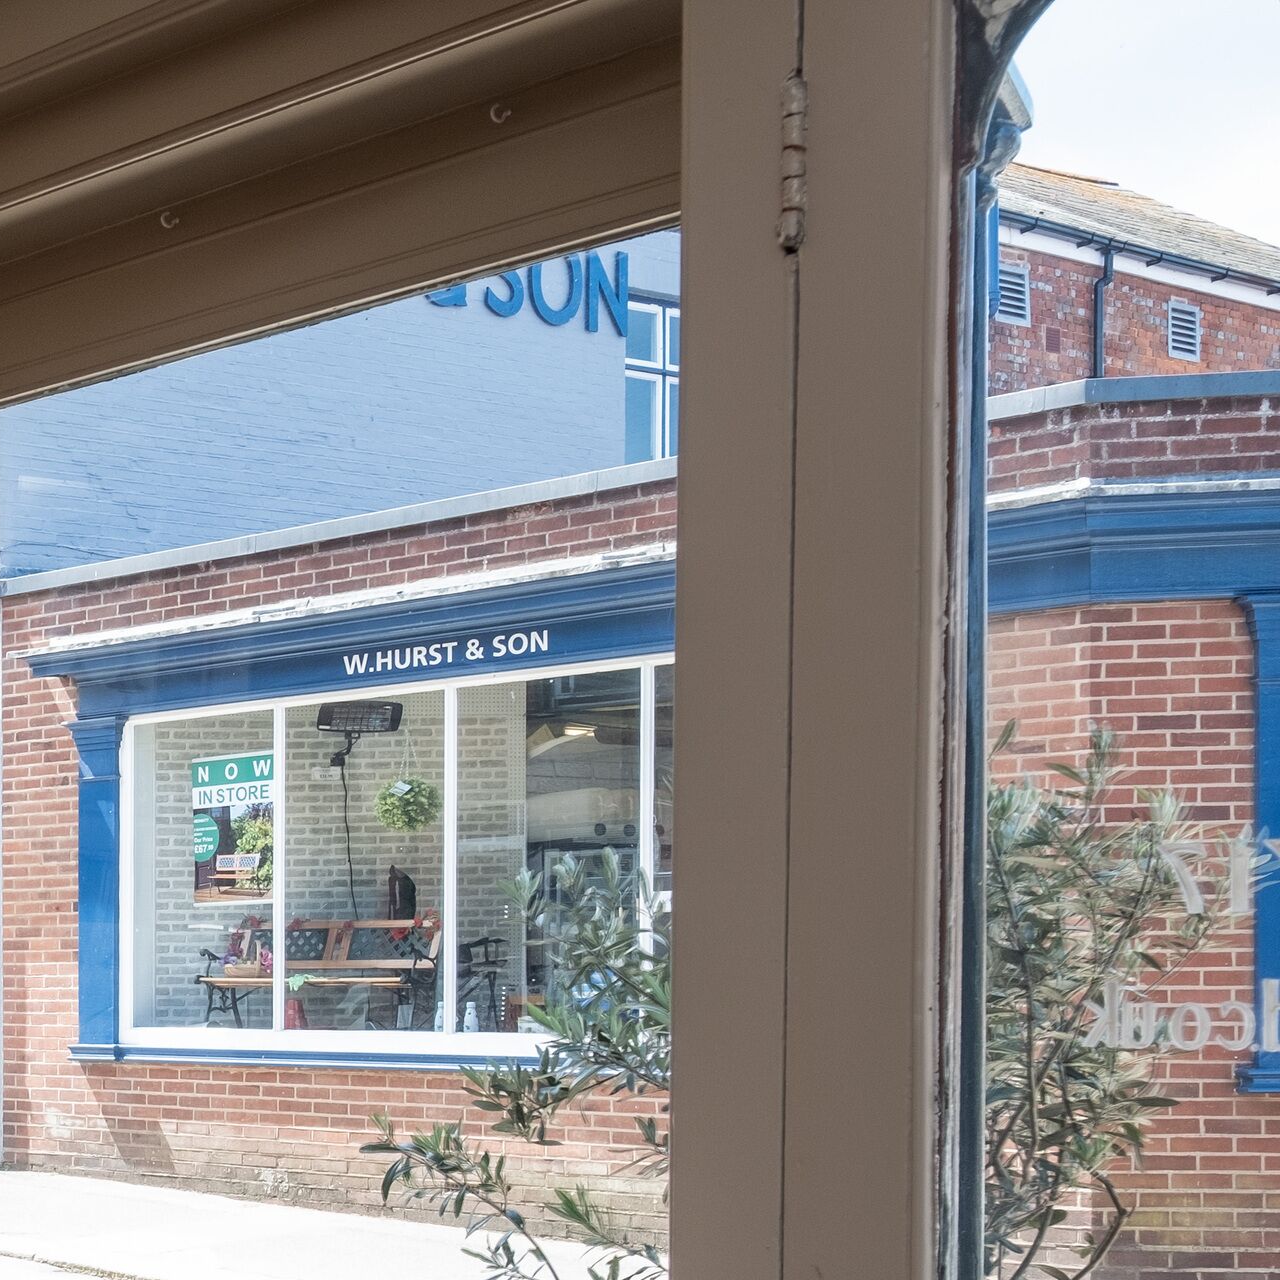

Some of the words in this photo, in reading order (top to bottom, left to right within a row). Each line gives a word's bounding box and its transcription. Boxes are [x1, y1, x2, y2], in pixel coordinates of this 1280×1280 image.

[484, 251, 628, 337] SON
[343, 641, 458, 676] W.HURST
[465, 639, 484, 661] &
[492, 630, 549, 657] SON
[198, 759, 271, 783] NOW
[198, 790, 212, 806] IN
[216, 784, 270, 804] STORE
